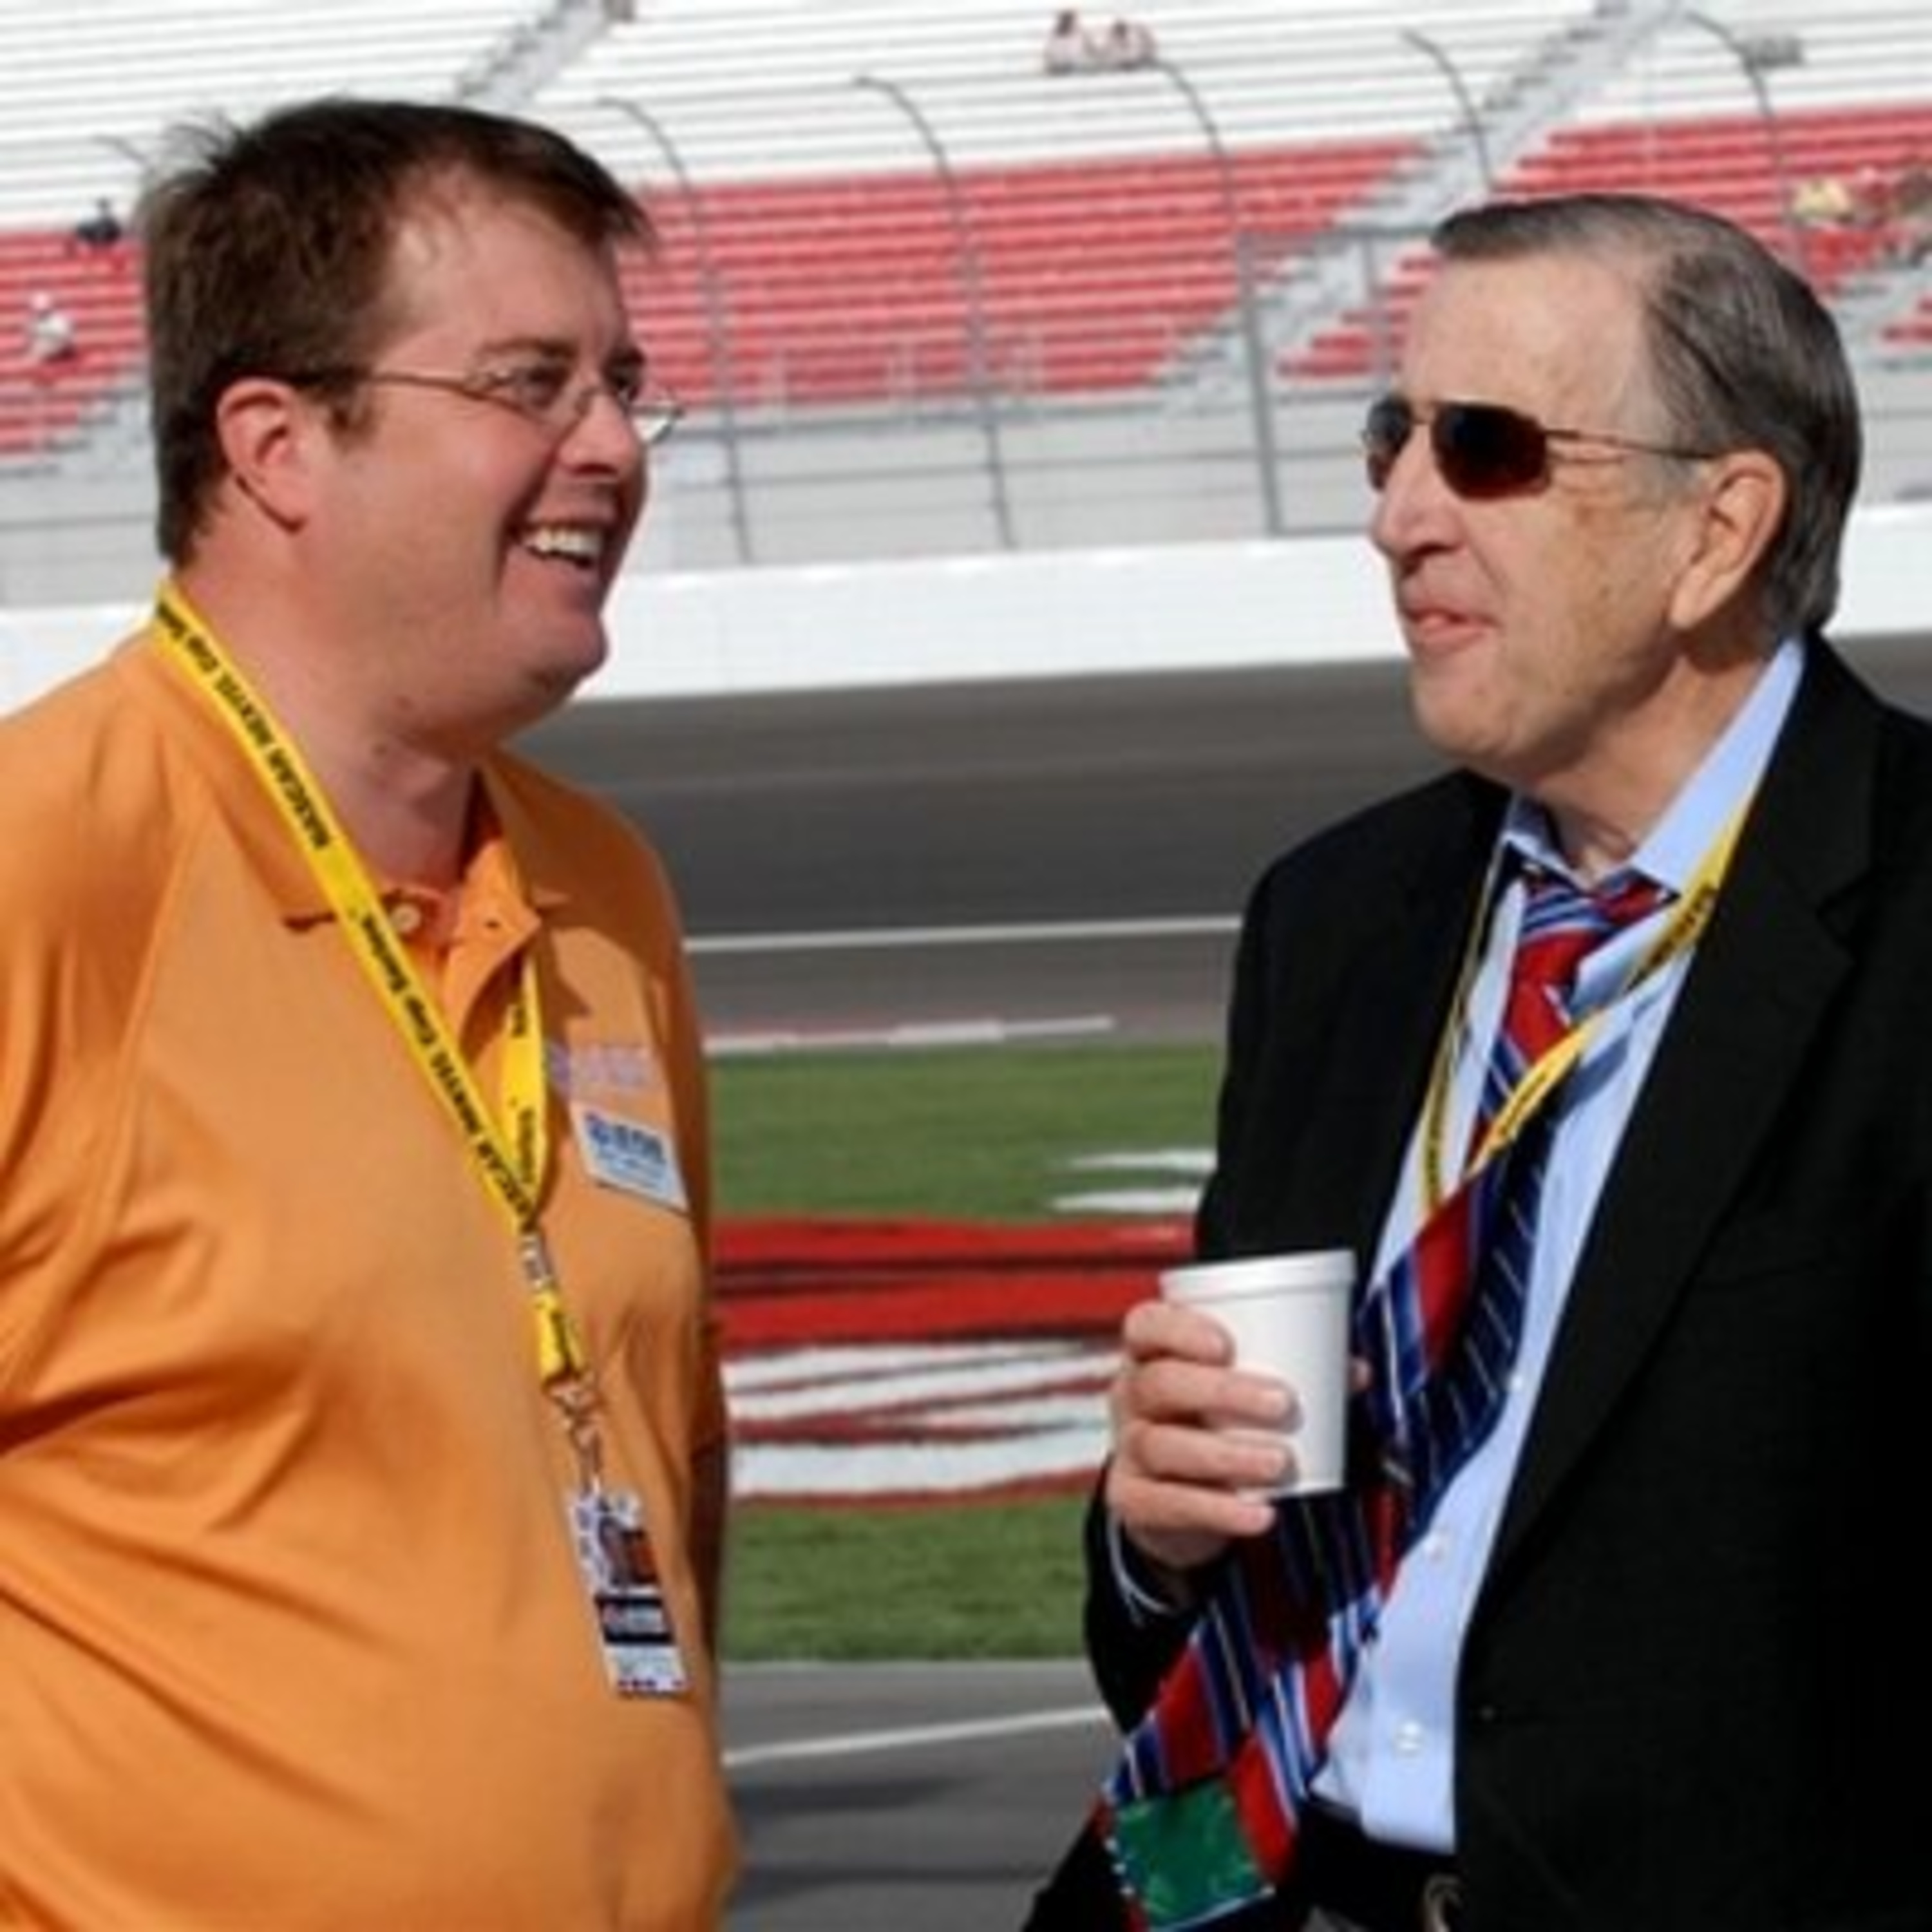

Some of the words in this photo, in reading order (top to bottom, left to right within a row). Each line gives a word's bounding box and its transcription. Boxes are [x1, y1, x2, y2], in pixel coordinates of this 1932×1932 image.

[265, 746, 331, 849] NASCAR
[362, 914, 410, 992] Series
[404, 995, 438, 1046] Cup
